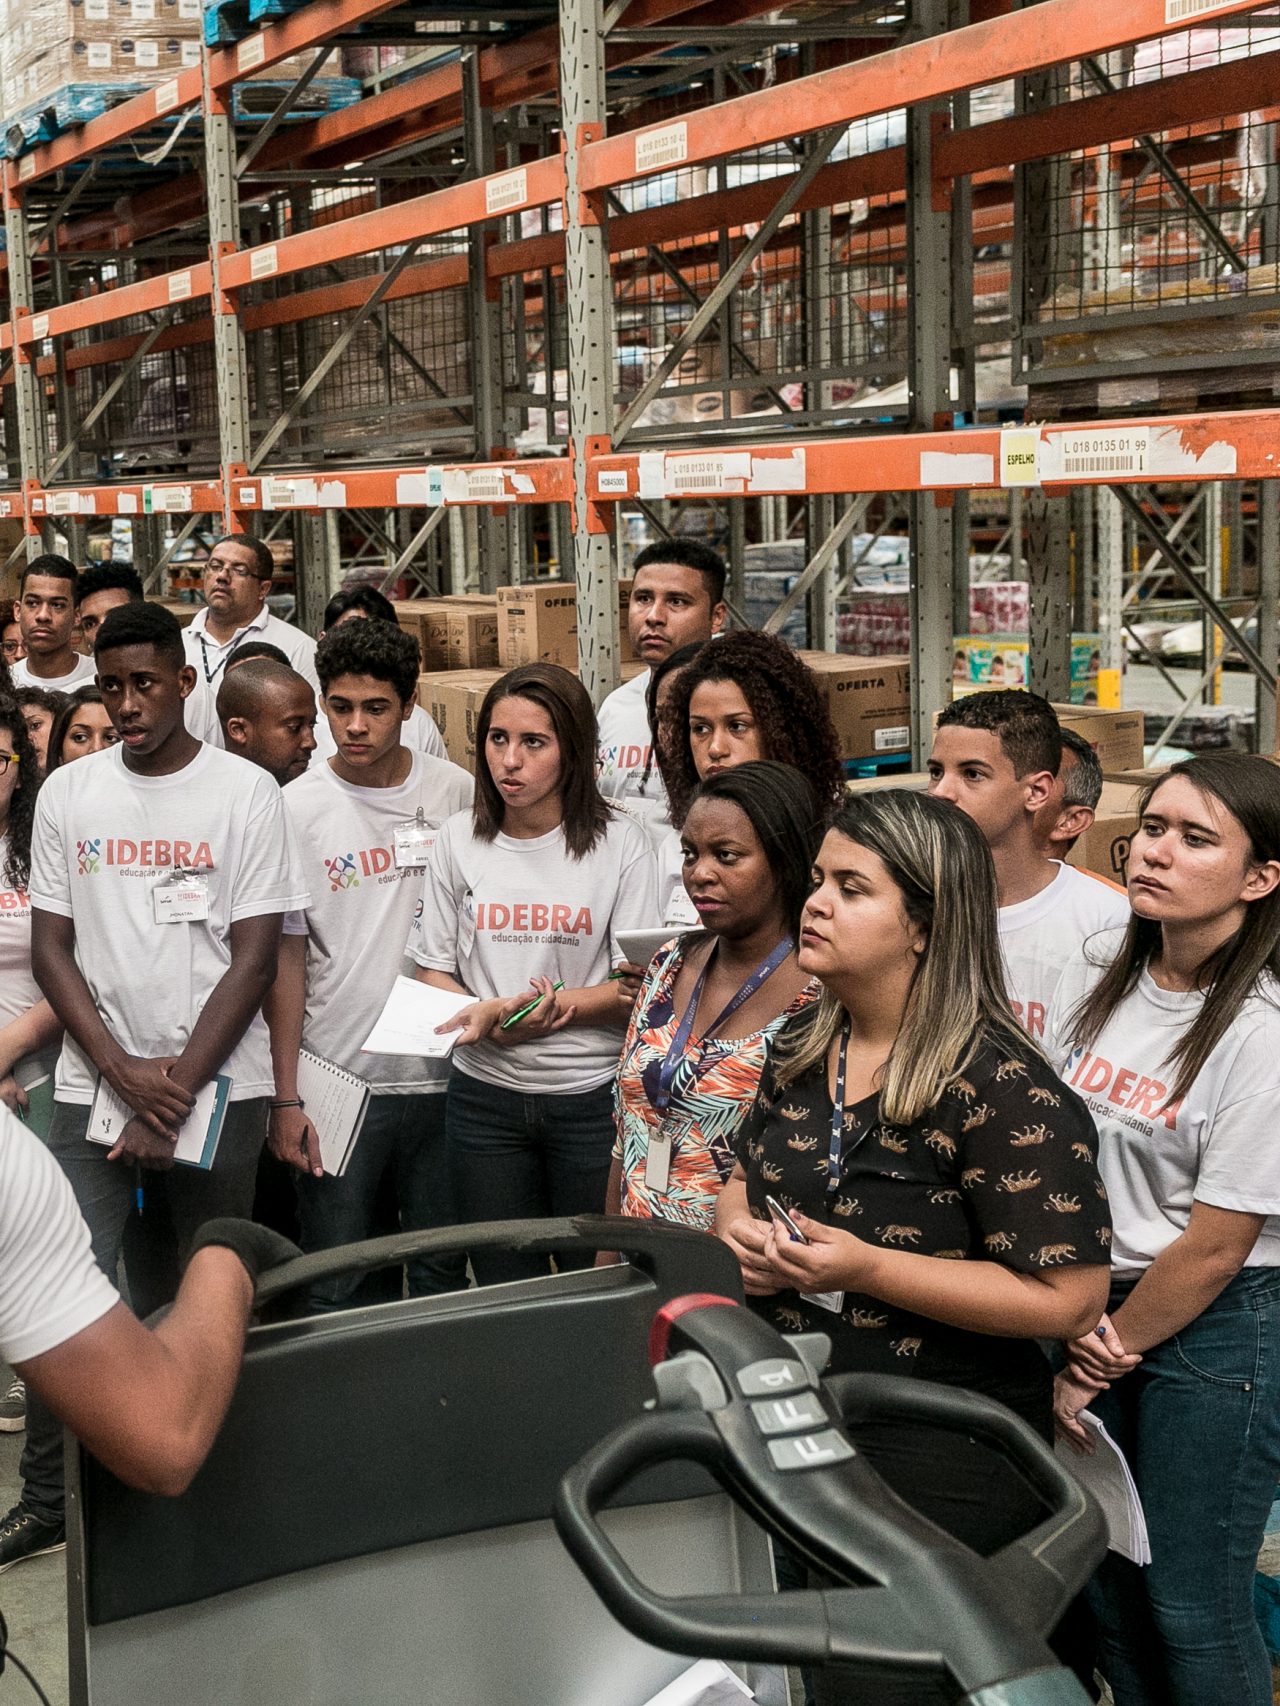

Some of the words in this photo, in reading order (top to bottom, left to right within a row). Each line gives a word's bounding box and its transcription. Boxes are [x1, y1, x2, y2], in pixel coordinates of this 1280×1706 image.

[1064, 442, 1070, 454] L
[1073, 441, 1090, 453] 018
[1093, 440, 1116, 452] 0135
[1119, 439, 1130, 451] 01
[1135, 440, 1146, 450] 99
[1007, 454, 1035, 466] ESPELHO
[545, 598, 576, 608] OFER
[836, 678, 885, 691] OFERTA
[106, 839, 215, 869] IDEBRA
[477, 903, 593, 936] IDEBRA
[491, 933, 533, 945] educação
[541, 932, 580, 947] cidadania
